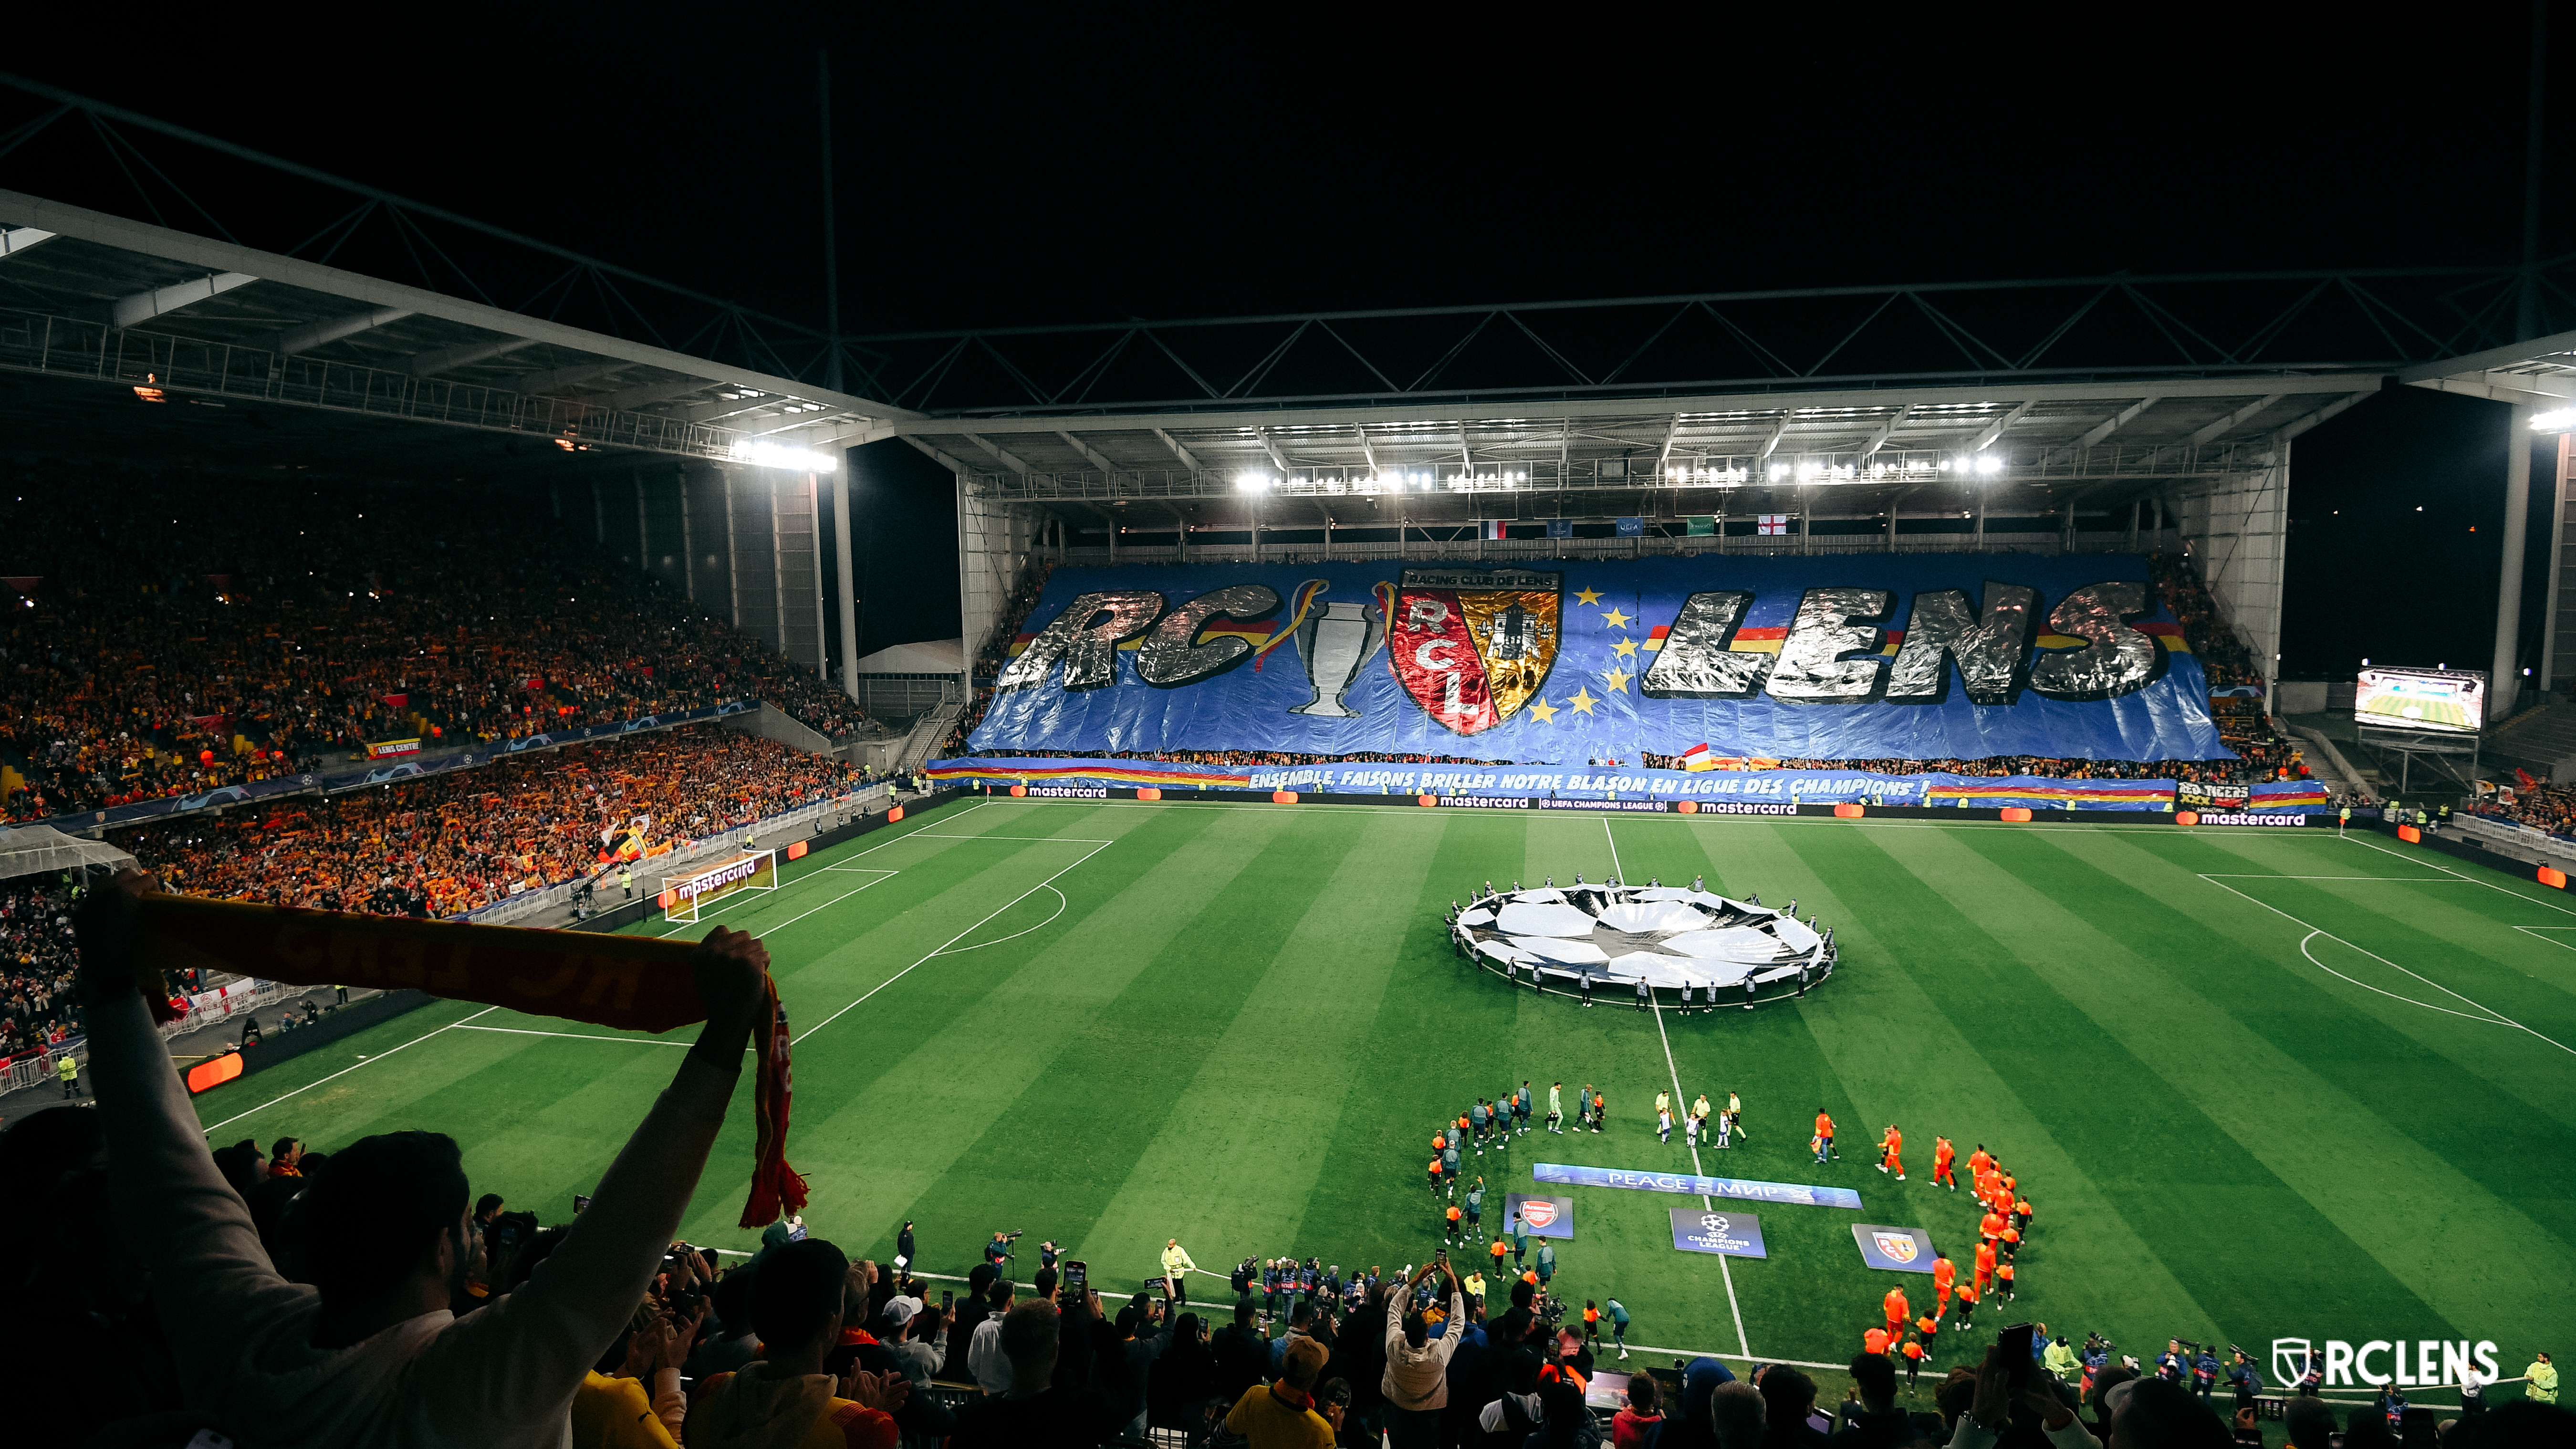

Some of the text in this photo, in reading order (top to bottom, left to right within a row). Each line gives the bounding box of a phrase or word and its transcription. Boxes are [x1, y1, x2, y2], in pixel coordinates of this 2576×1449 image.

[1408, 574, 1553, 586] RACING CLUB DE LENS
[998, 581, 2169, 705] RC LENS
[378, 742, 419, 754] LENS CENTRE
[1249, 769, 1335, 789] ENSEMBLE,
[1340, 770, 1416, 787] FAISONS
[1419, 769, 1497, 788] BRILLER
[1500, 773, 1563, 790] NOTRE
[1566, 774, 1648, 792] BLASON
[1648, 778, 1679, 794] EN
[1679, 779, 1741, 794] LIGUE
[1743, 778, 1784, 794] DES
[1789, 778, 1915, 796] CHAMPIONS
[1029, 786, 1107, 798] mastercard
[2178, 782, 2249, 798] RED TIGERS
[1440, 795, 1529, 808] mastercard
[1552, 800, 1654, 810] UEFA CHAMPIONS LEAGUE
[1701, 802, 1797, 815] mastercard
[2201, 813, 2305, 826] mastercard
[1609, 1173, 1690, 1191] PEACE
[1687, 1235, 1750, 1247] CHAMPIONS
[1699, 1241, 1741, 1251] LEAGUE
[1880, 1239, 1905, 1260] RCL
